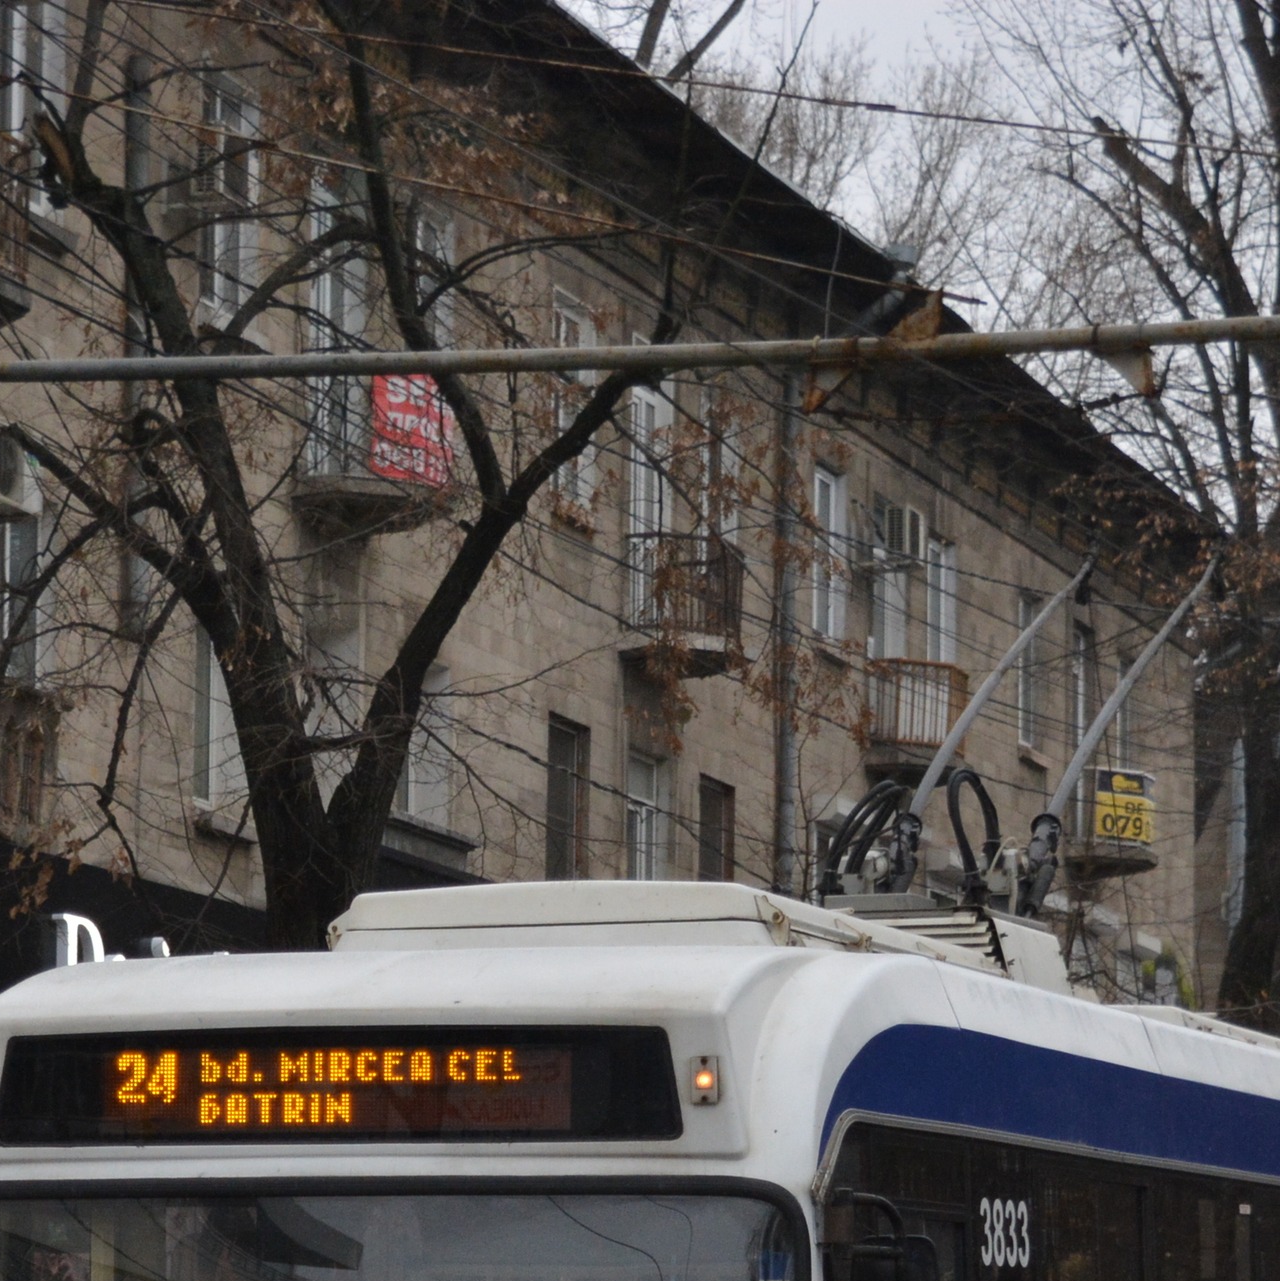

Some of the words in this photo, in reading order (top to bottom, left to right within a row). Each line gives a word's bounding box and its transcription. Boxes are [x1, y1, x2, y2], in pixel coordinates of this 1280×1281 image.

[1102, 813, 1143, 837] 079
[117, 1052, 176, 1103] 24
[200, 1052, 263, 1083] bd.
[280, 1050, 432, 1083] MIRCEA
[448, 1050, 521, 1082] CEL
[980, 1197, 1030, 1268] 3833
